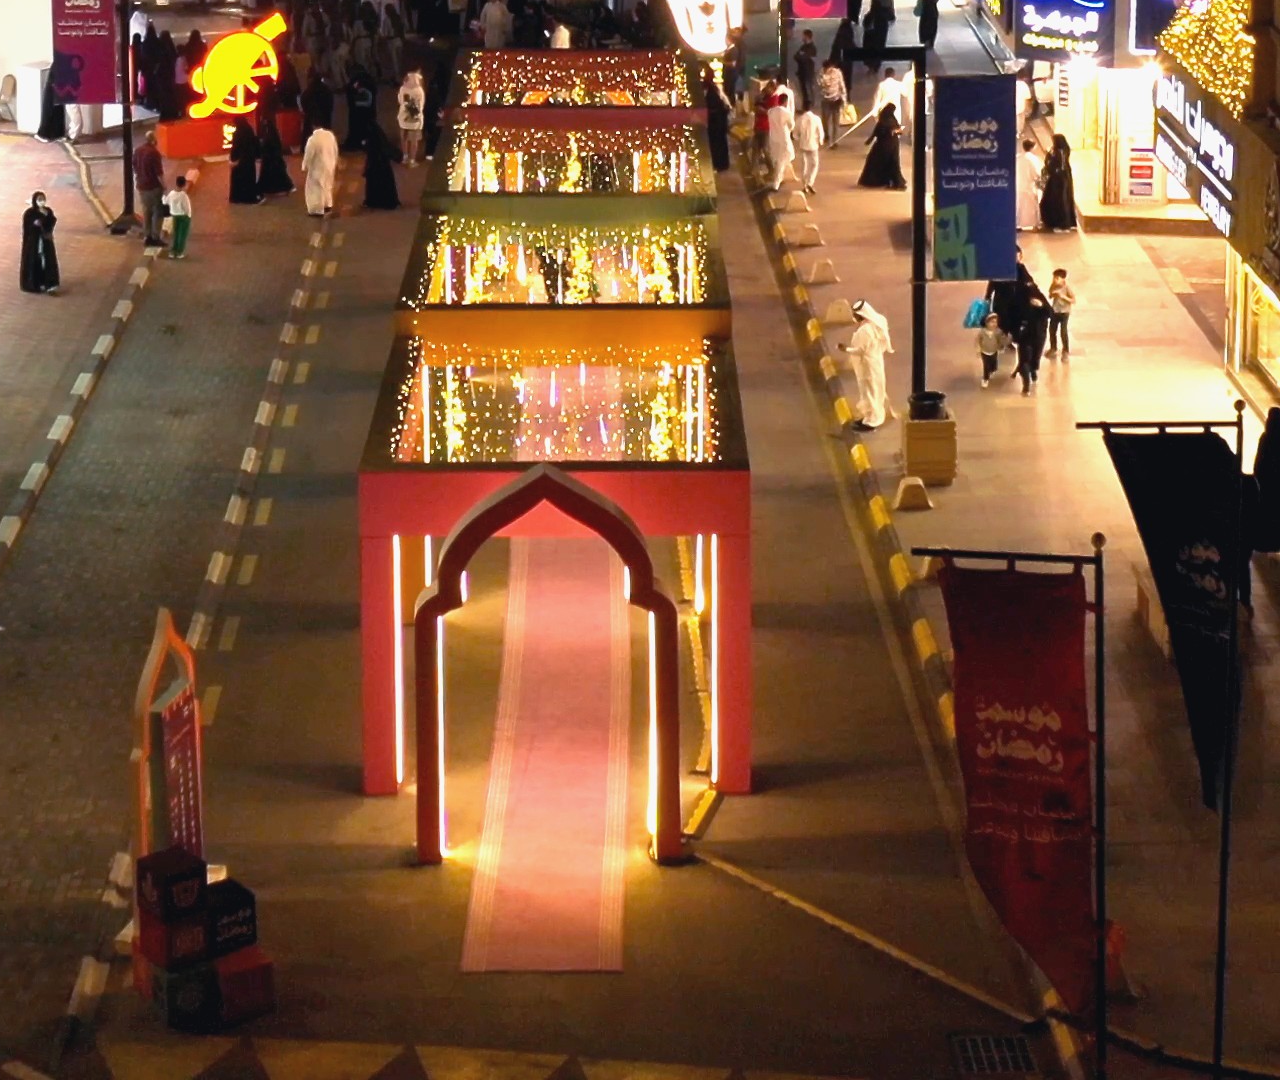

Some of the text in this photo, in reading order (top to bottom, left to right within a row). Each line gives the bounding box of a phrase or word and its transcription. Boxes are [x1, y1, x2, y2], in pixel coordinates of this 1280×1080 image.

[952, 117, 998, 134] موسم
[952, 133, 998, 152] رمضان
[975, 696, 1062, 732] موسم
[975, 726, 1065, 773] رمضان
